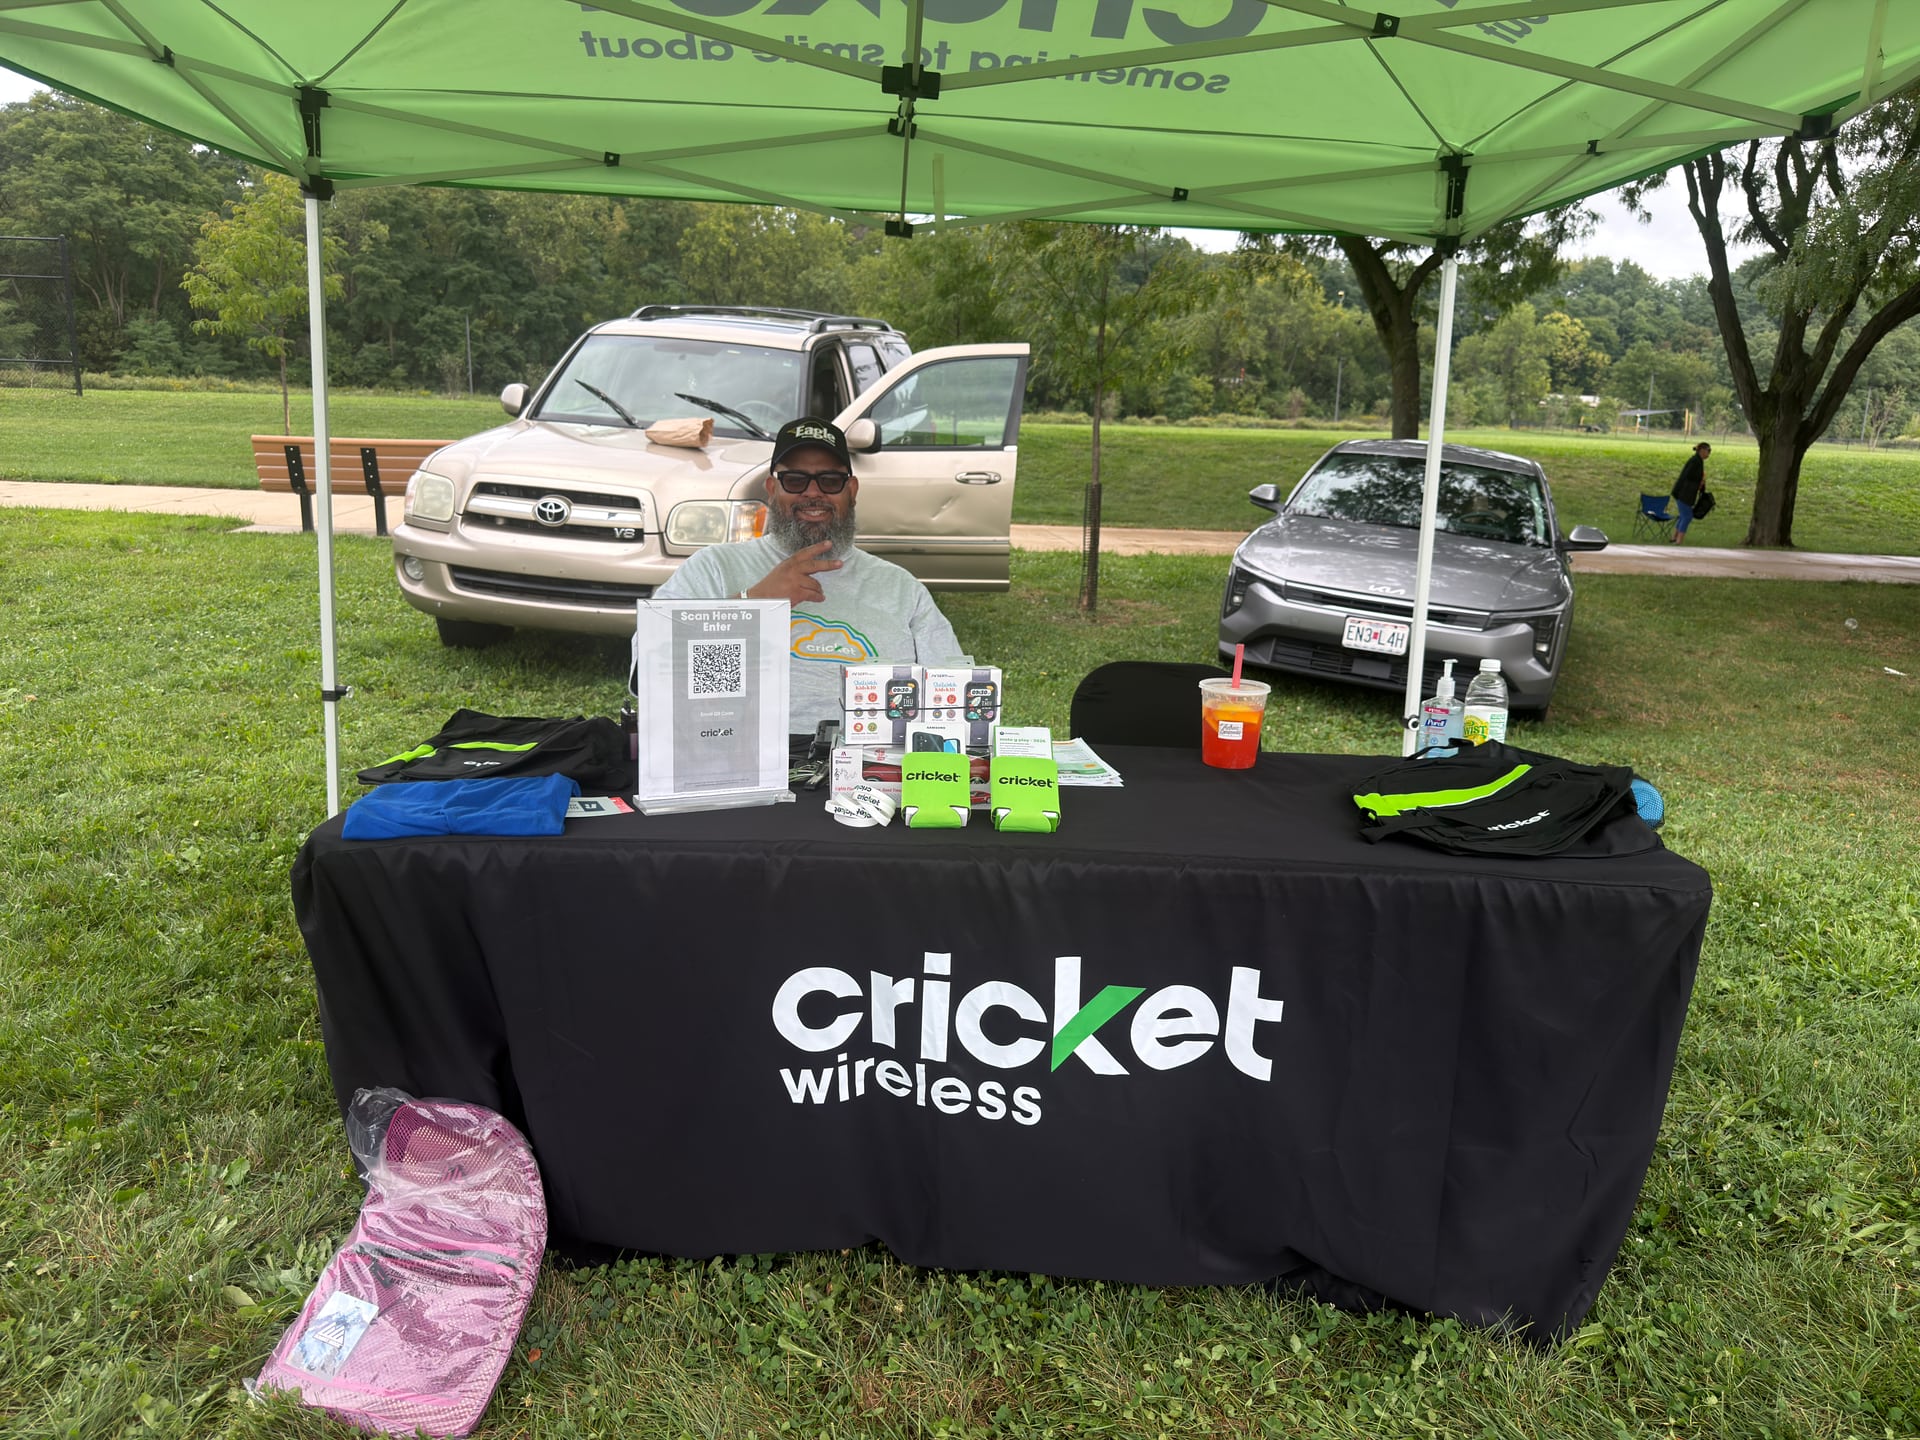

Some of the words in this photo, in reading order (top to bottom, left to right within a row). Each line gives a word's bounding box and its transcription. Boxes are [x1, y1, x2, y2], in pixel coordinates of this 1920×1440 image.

[795, 425, 836, 441] Eagle
[614, 527, 635, 539] V8
[680, 611, 710, 621] Scan
[712, 611, 738, 620] Here
[740, 610, 752, 620] To
[703, 622, 731, 632] Enter
[1346, 624, 1373, 643] EN3
[1377, 630, 1405, 649] L4H
[806, 643, 857, 656] cricket
[700, 727, 735, 738] cricket
[906, 770, 961, 783] cricket
[998, 776, 1055, 788] cricket
[772, 952, 1284, 1082] cricket
[779, 1052, 1043, 1126] wireless
[421, 1285, 444, 1295] CHINA
